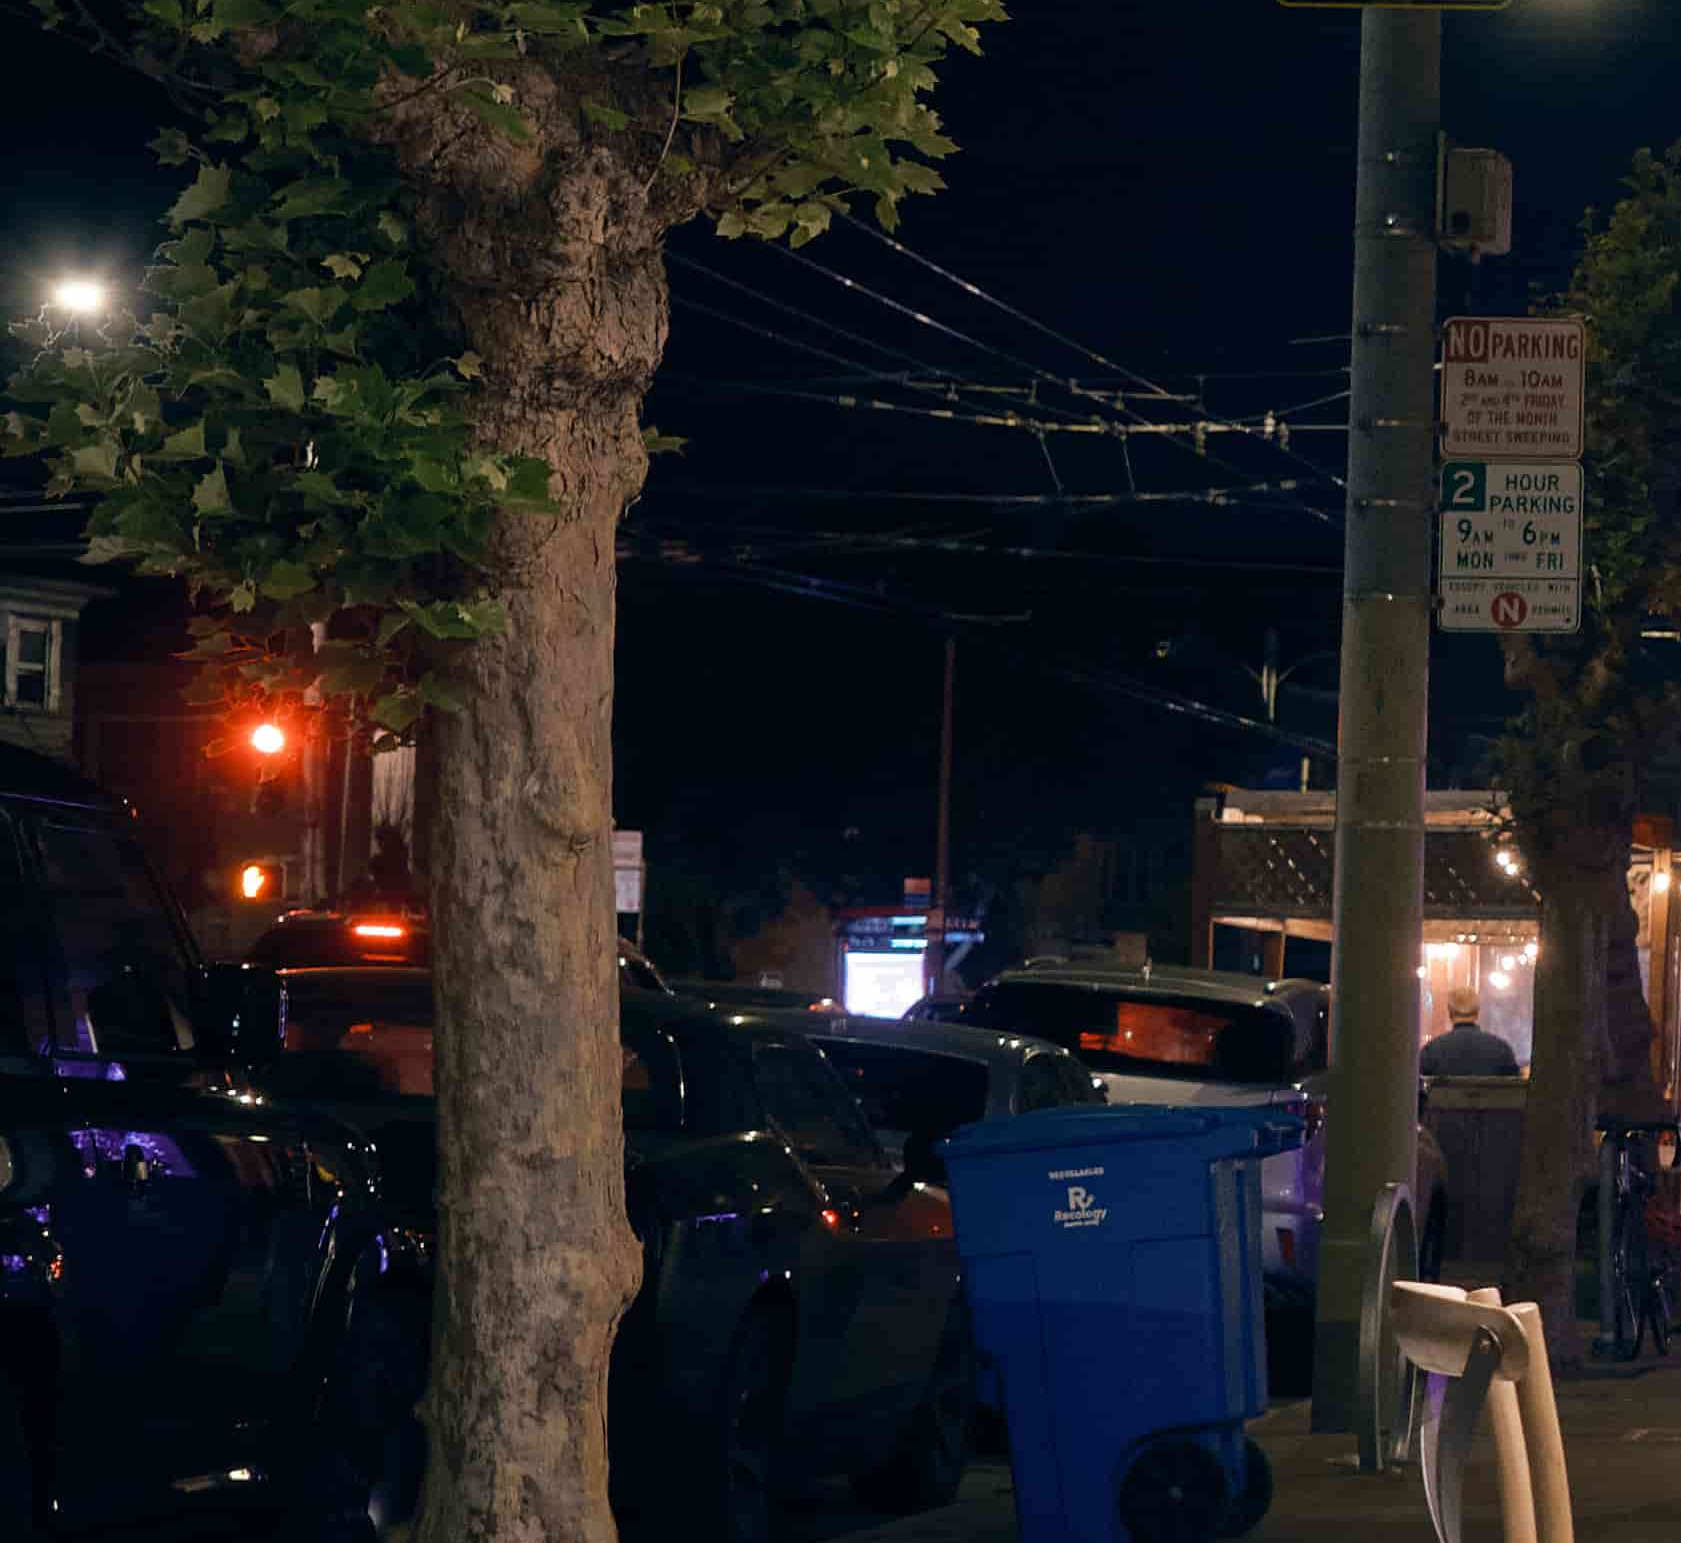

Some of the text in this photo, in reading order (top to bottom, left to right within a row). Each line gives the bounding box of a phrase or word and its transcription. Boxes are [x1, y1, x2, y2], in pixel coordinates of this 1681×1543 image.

[1449, 323, 1578, 359] NO PARKING
[1463, 369, 1498, 387] 8AM
[1519, 370, 1563, 387] 10AM
[1524, 393, 1566, 408] FRIDAY
[1467, 410, 1559, 427] OF THE MONTH
[1453, 430, 1571, 443] STREET SWEEPING
[1451, 469, 1560, 506] 2 HOUR
[1489, 495, 1575, 514] PARKING
[1457, 518, 1494, 544] 9AM
[1522, 521, 1561, 545] 6PM
[1457, 552, 1494, 570] MON
[1535, 553, 1564, 570] FRI
[1497, 596, 1522, 624] N
